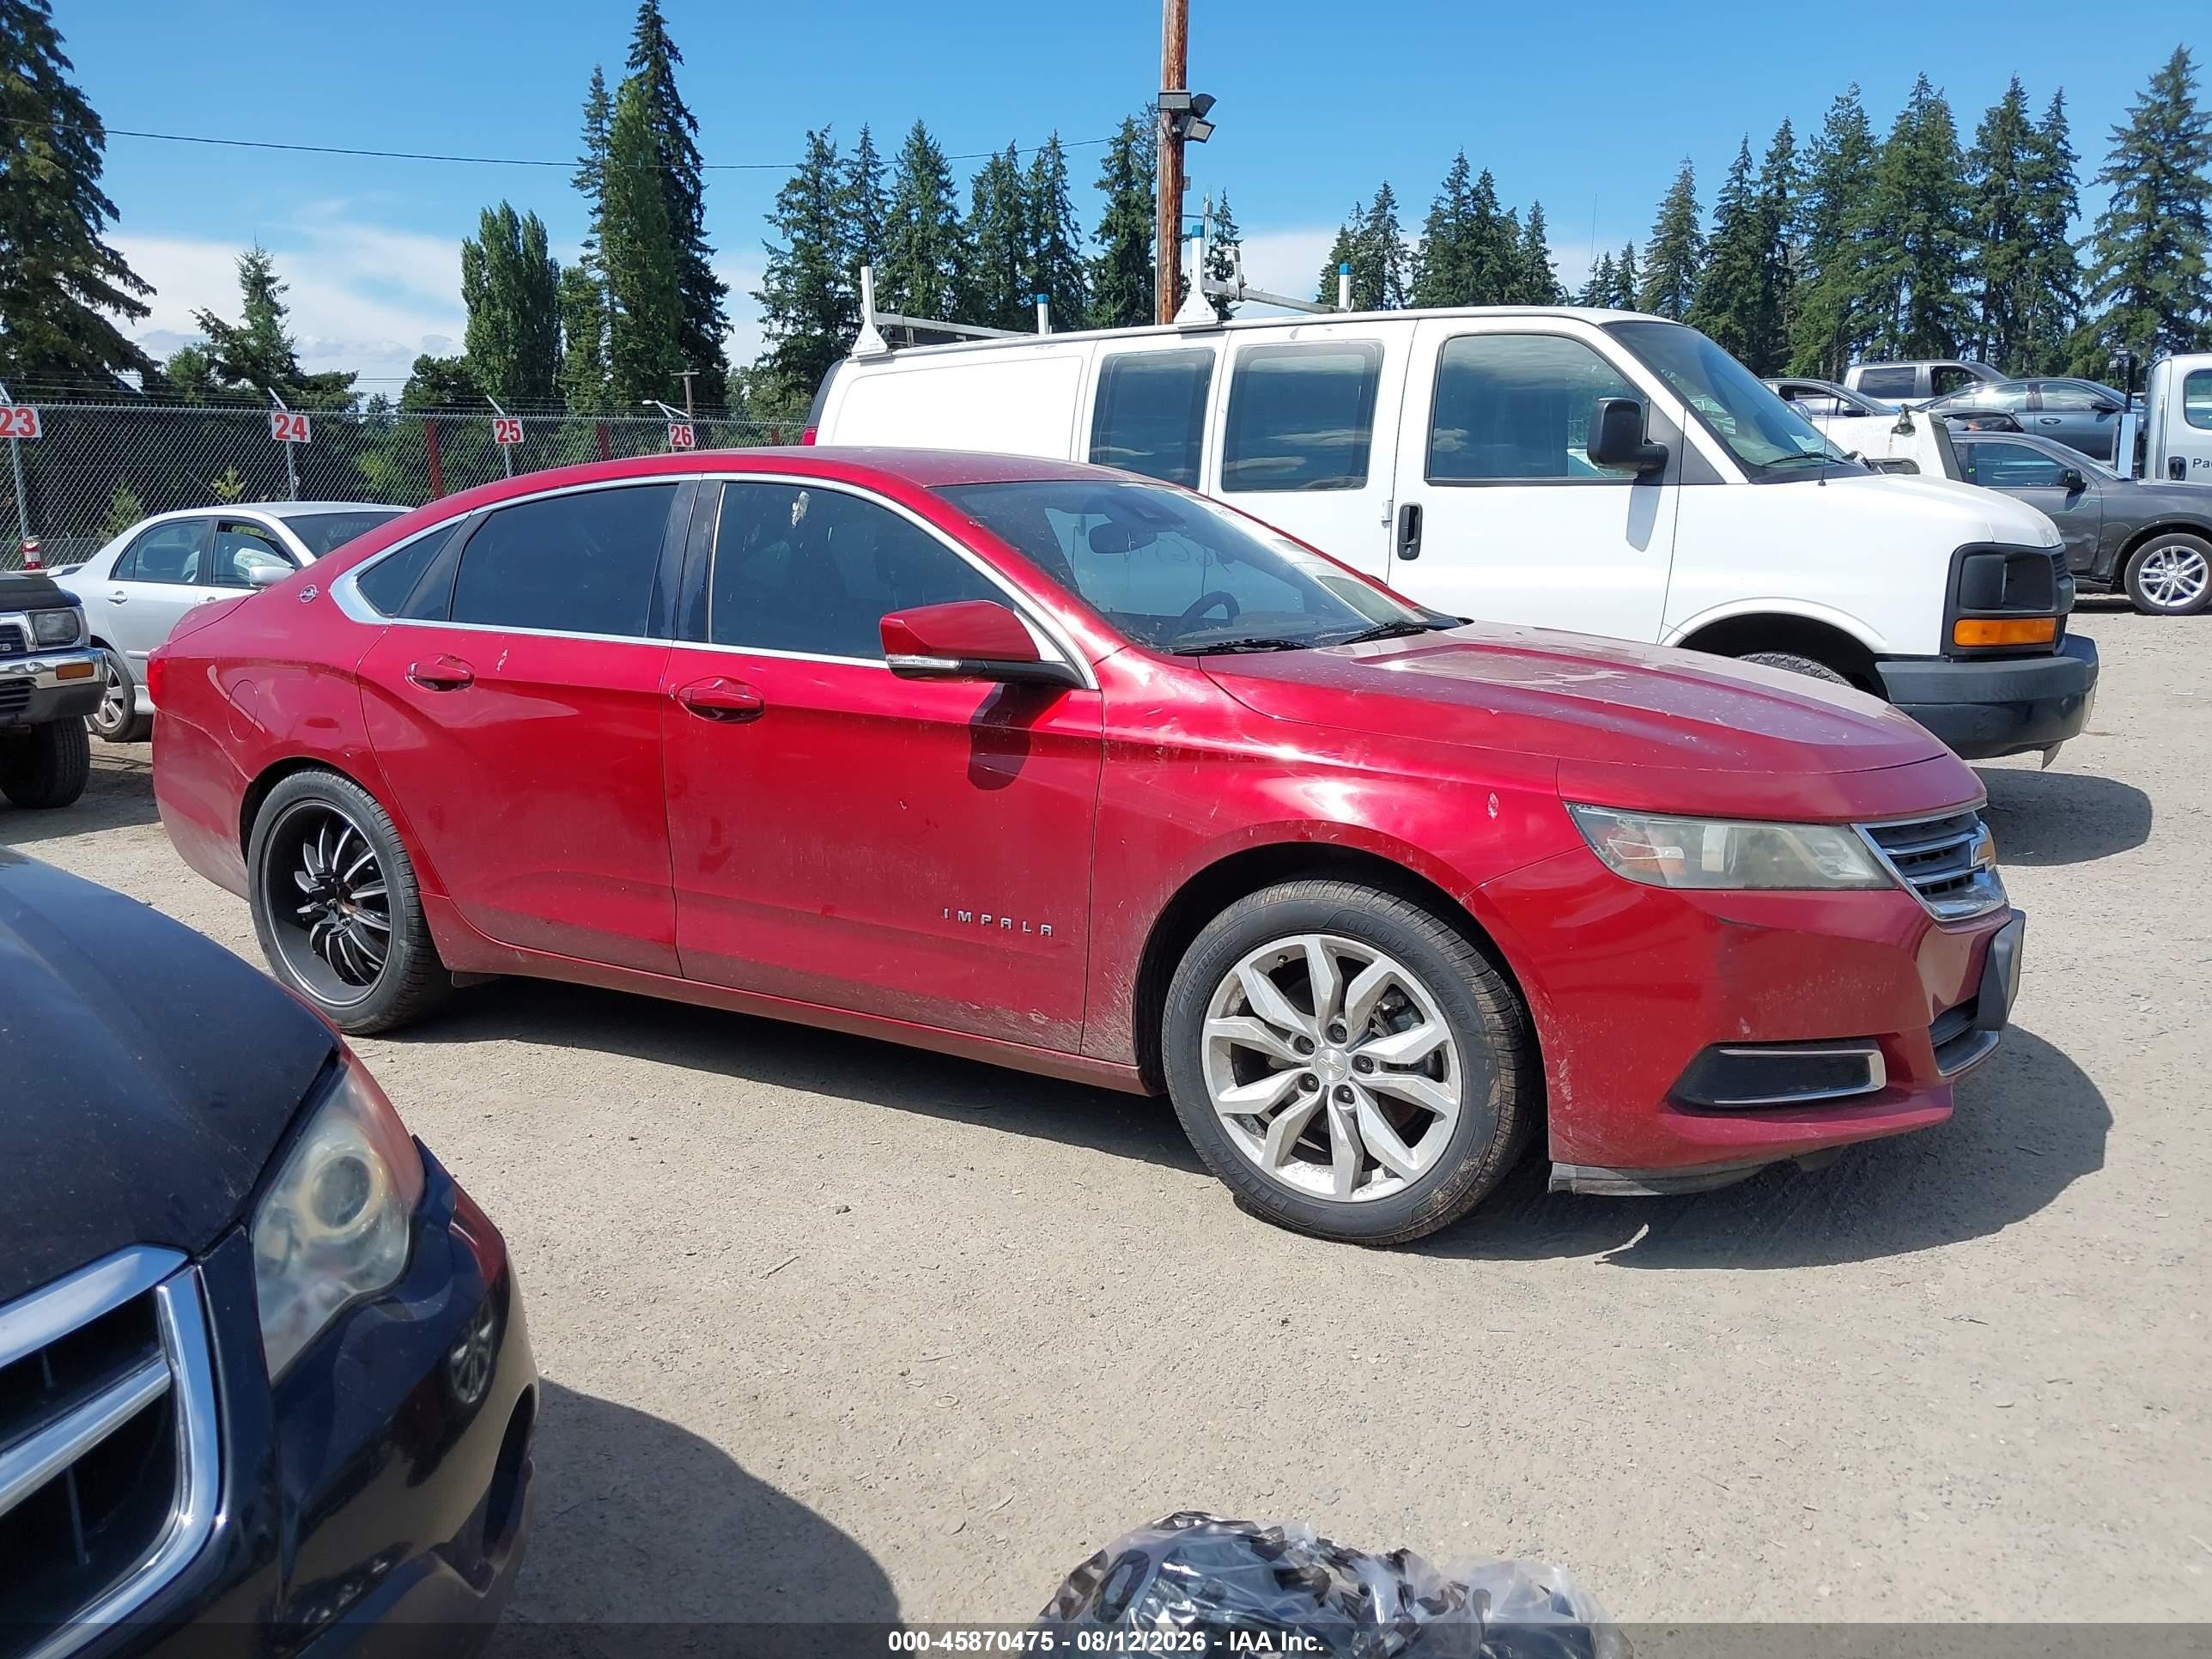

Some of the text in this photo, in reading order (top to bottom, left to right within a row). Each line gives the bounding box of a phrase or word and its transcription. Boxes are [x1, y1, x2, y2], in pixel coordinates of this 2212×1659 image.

[0, 407, 36, 436] 23
[275, 414, 307, 441] 24
[495, 420, 521, 442] 25
[671, 425, 692, 446] 26
[2192, 458, 2212, 469] Pa
[944, 908, 1053, 937] IMPALA
